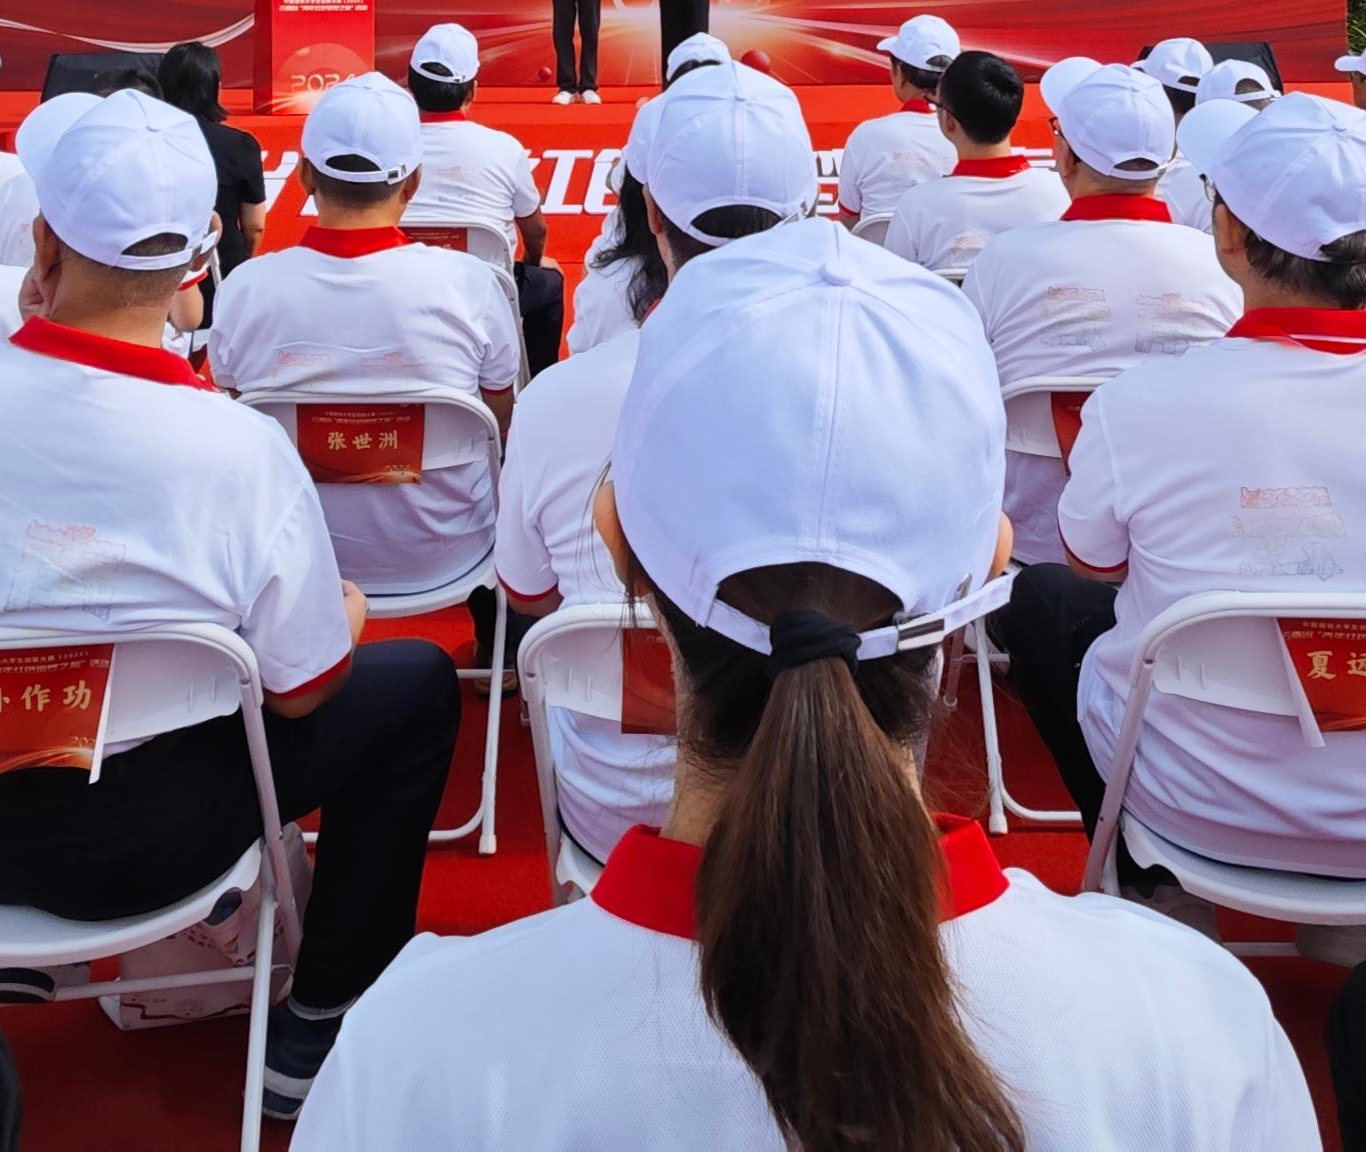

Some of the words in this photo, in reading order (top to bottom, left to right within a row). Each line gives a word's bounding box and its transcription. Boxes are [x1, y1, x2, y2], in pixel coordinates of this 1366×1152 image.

[291, 73, 356, 95] 202
[327, 430, 399, 450] 张世洲
